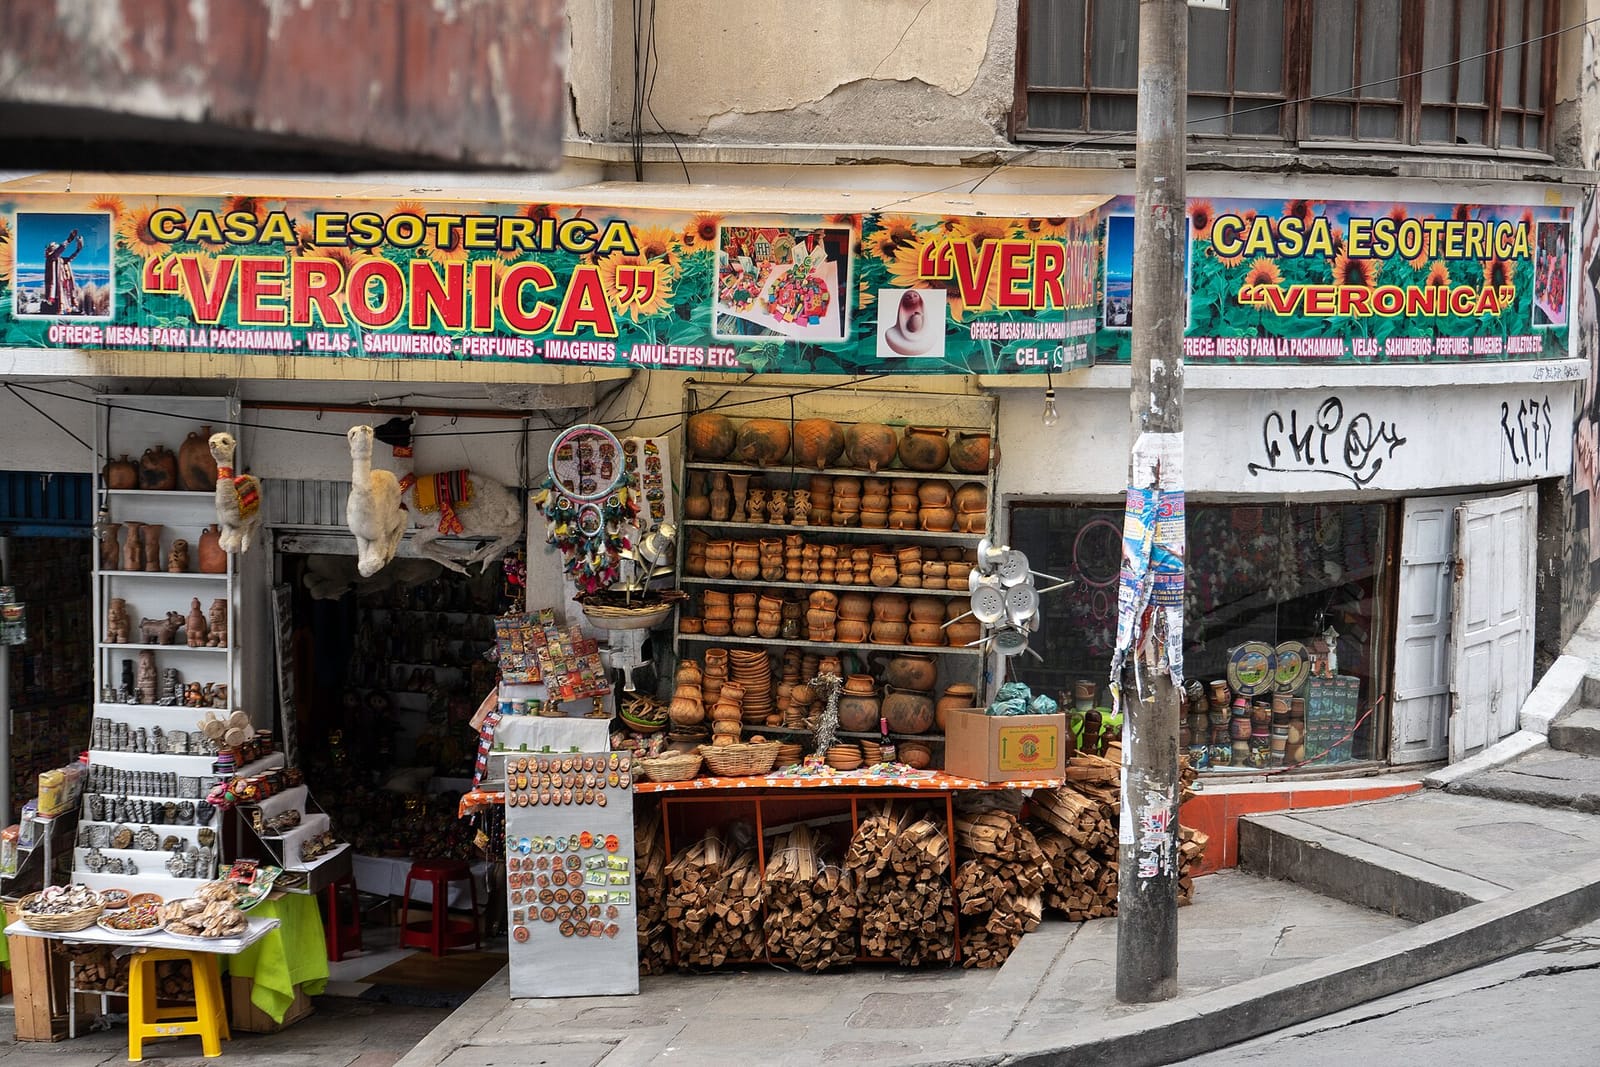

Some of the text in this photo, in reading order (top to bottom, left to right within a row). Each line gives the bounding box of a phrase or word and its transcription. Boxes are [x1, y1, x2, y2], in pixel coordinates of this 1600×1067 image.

[149, 208, 640, 256] CASA ESOTERICA
[1211, 214, 1532, 261] CASA ESOTERICA
[49, 325, 103, 344] OFRECE:
[106, 327, 149, 345] MESAS
[151, 328, 188, 346] PARA
[190, 329, 207, 347] LA
[209, 329, 293, 350] PACHAMAMA
[307, 332, 350, 351] VELAS
[363, 334, 451, 354] SAHUMERIOS
[462, 337, 535, 357] PERFUMES
[544, 340, 616, 361] IMAGENES
[630, 344, 704, 365] AMULETES
[707, 348, 739, 366] ETC.
[970, 322, 999, 340] OFRECE:
[999, 322, 1020, 340] MESAS
[1021, 322, 1036, 340] PARA
[1036, 322, 1044, 340] LA
[1216, 337, 1249, 356] MESAS
[1250, 338, 1275, 356] PARA
[1277, 338, 1290, 356] LA
[1290, 337, 1344, 357] PACHAMAMA
[1352, 338, 1378, 356] VELAS
[1385, 338, 1432, 356] SAHUMERIOS
[1436, 337, 1469, 355] PERFUMES
[1473, 337, 1502, 355] IMAGENES
